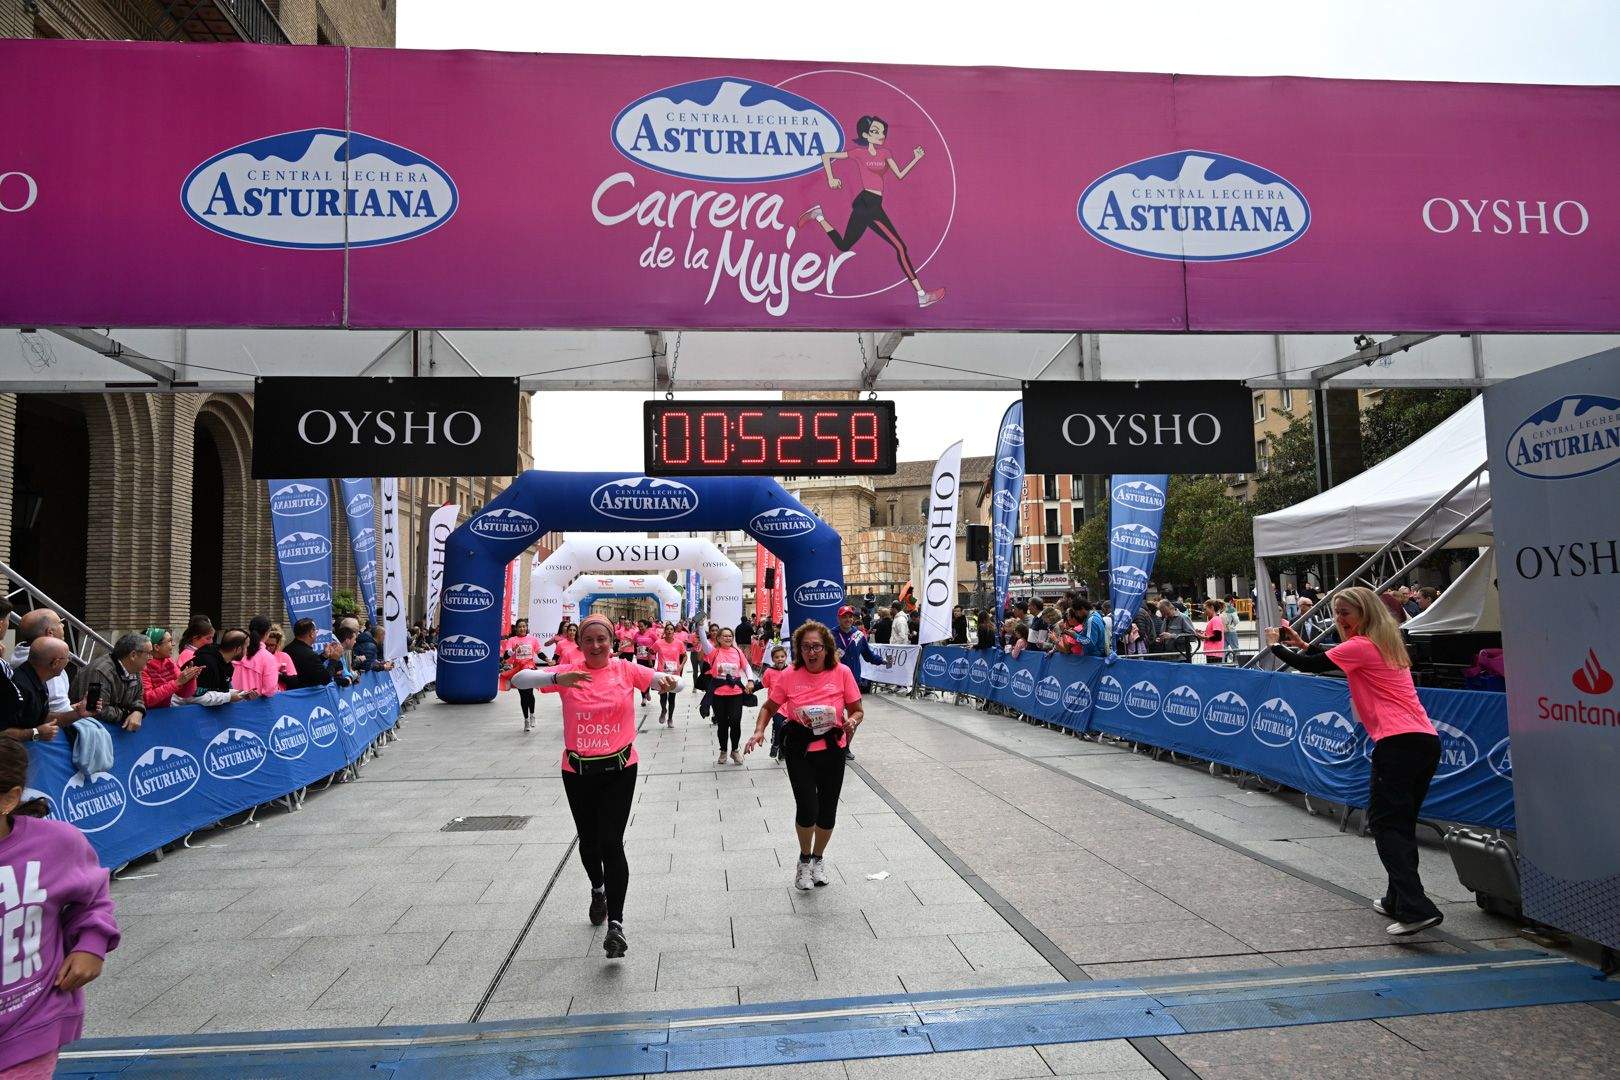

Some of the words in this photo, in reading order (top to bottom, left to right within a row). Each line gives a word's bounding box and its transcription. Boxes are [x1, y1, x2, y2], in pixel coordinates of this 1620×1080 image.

[666, 112, 740, 123] CENTRAL
[746, 114, 819, 126] LECHERA
[630, 113, 825, 157] ASTURIANA
[247, 169, 333, 182] CENTRAL
[342, 170, 429, 183] LECHERA
[203, 171, 437, 219] ASTURIANA
[591, 171, 785, 230] Carrera
[1132, 188, 1205, 199] CENTRAL
[1211, 189, 1285, 200] LECHERA
[1097, 190, 1294, 233] ASTURIANA
[1422, 197, 1590, 236] OYSHO
[639, 231, 676, 269] de
[684, 230, 709, 270] la
[704, 225, 857, 317] Mujer
[298, 409, 482, 446] OYSHO
[1062, 412, 1222, 447] OYSHO
[599, 490, 690, 510] ASTURIANA
[1116, 489, 1163, 506] ASTURIANA
[474, 519, 533, 532] ASTURIANA
[756, 520, 812, 531] ASTURIANA
[926, 472, 955, 607] OYSHO
[596, 544, 680, 562] OYSHO
[576, 712, 591, 720] TU
[1165, 698, 1197, 718] ASTURIANA
[1206, 705, 1245, 727] ASTURIANA
[312, 722, 337, 740] ASTURIANA
[275, 733, 307, 752] ASTURIANA
[576, 738, 610, 748] SUMA
[210, 745, 263, 772] ASTURIANA
[135, 765, 196, 798] ASTURIANA
[67, 790, 123, 823] ASTURIANA
[0, 905, 44, 985] ER
